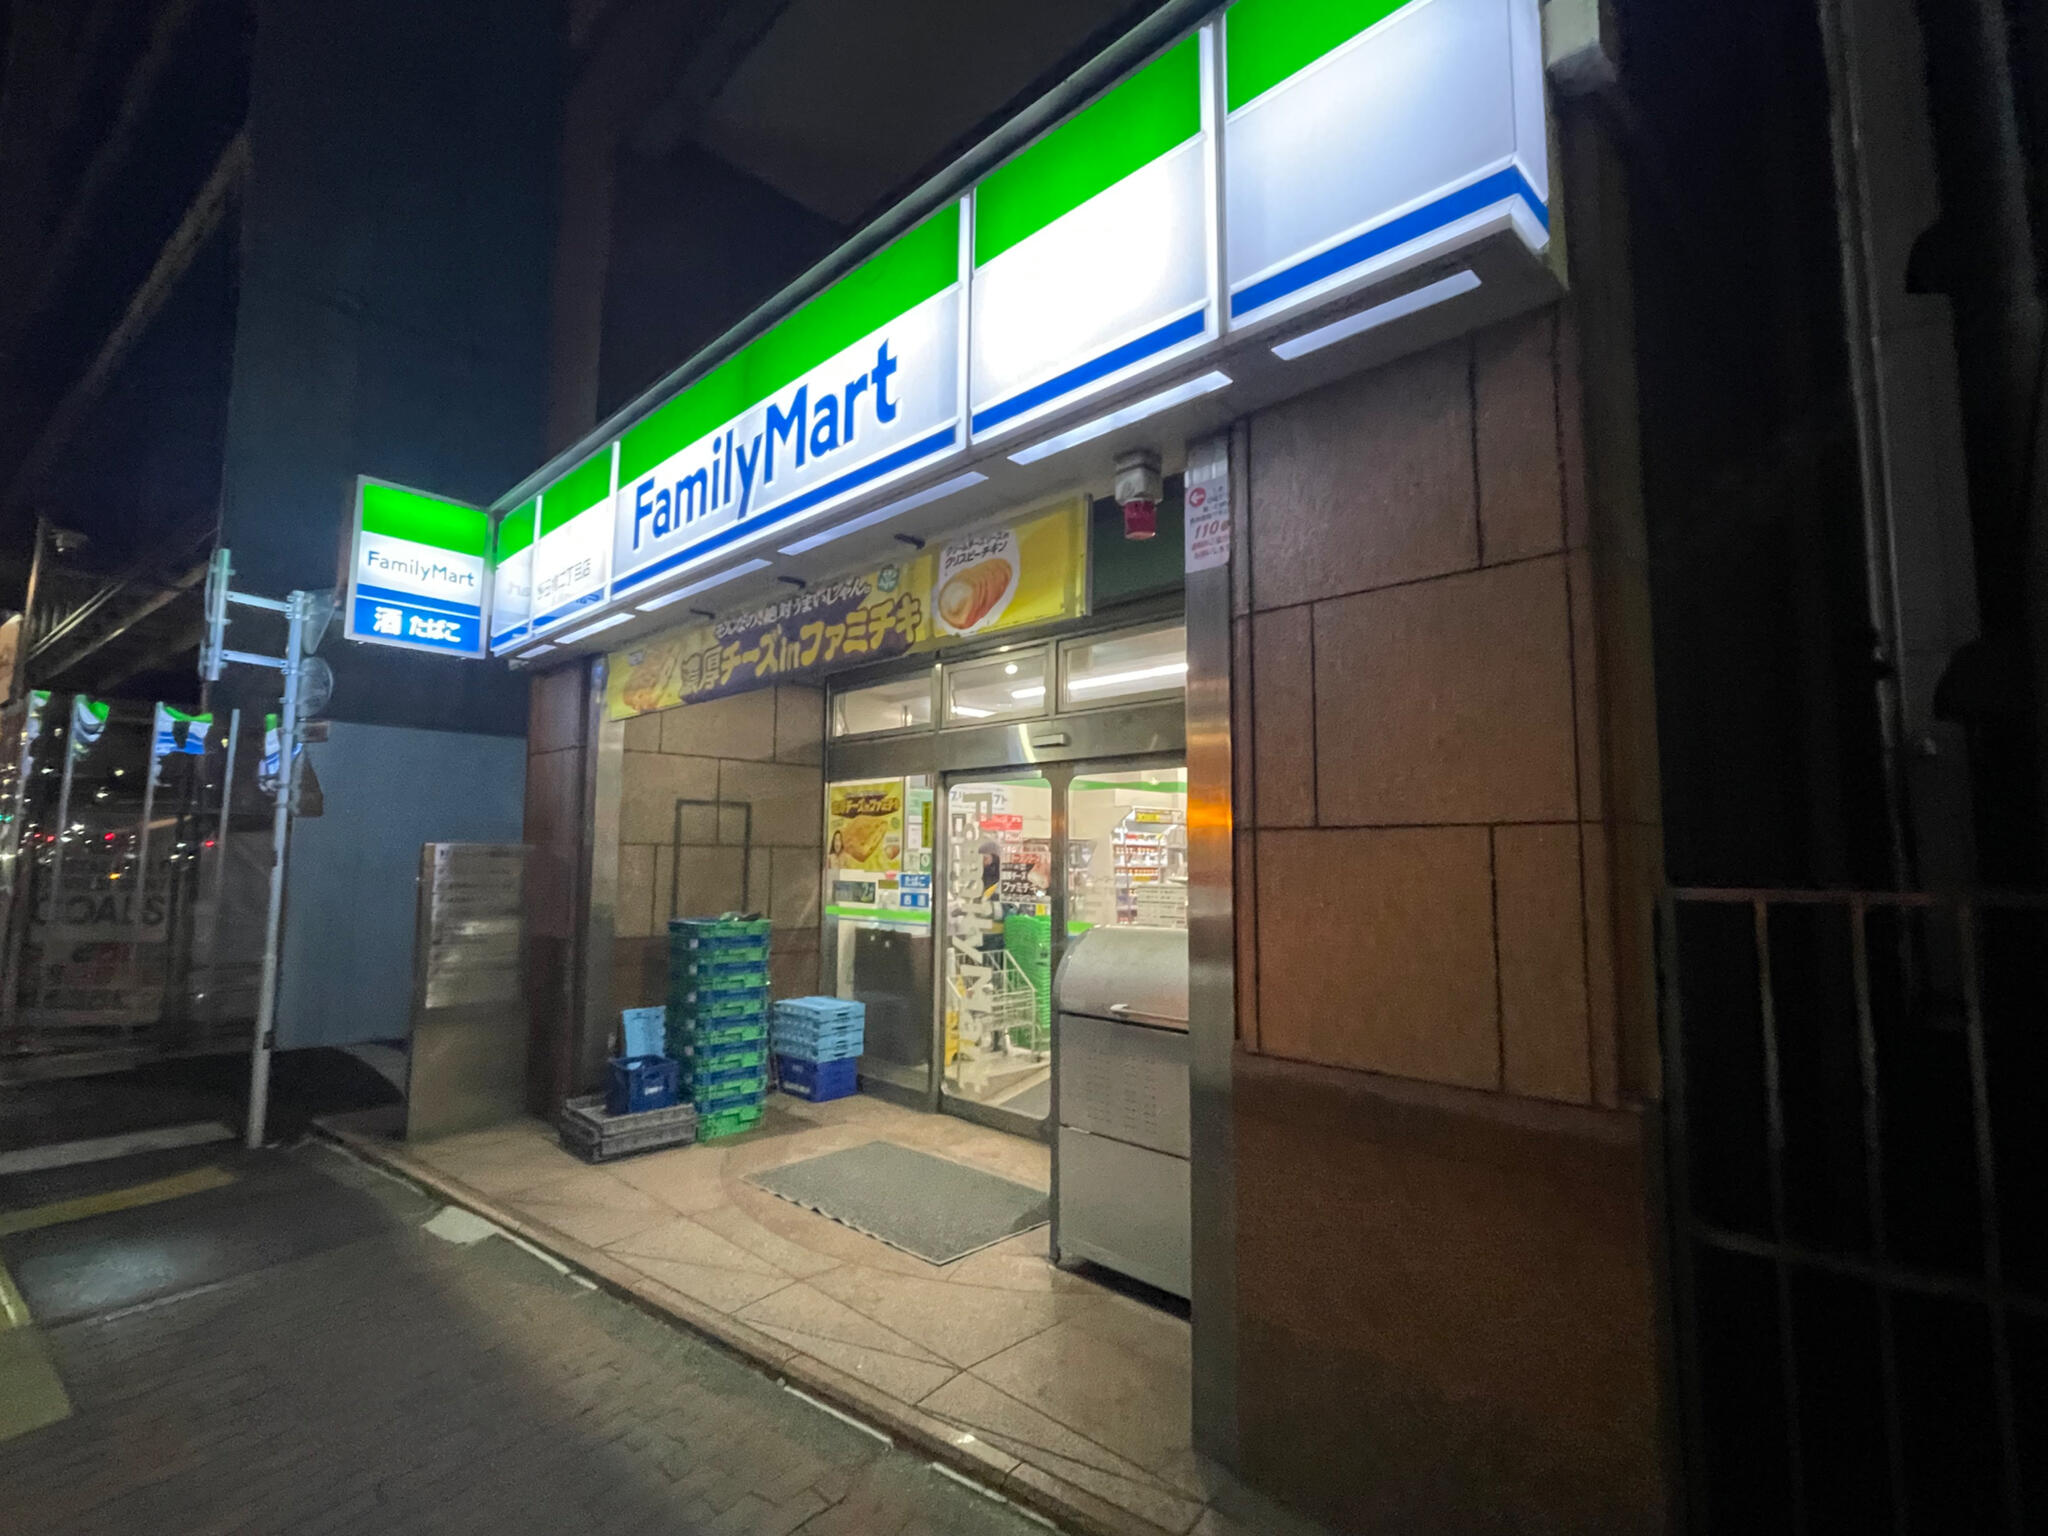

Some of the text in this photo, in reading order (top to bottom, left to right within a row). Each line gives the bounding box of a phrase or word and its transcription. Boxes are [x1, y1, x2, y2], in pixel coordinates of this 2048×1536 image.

[633, 338, 898, 551] FamilyMart
[367, 550, 475, 587] FamilyMart
[373, 606, 461, 643] 酒 たばこ
